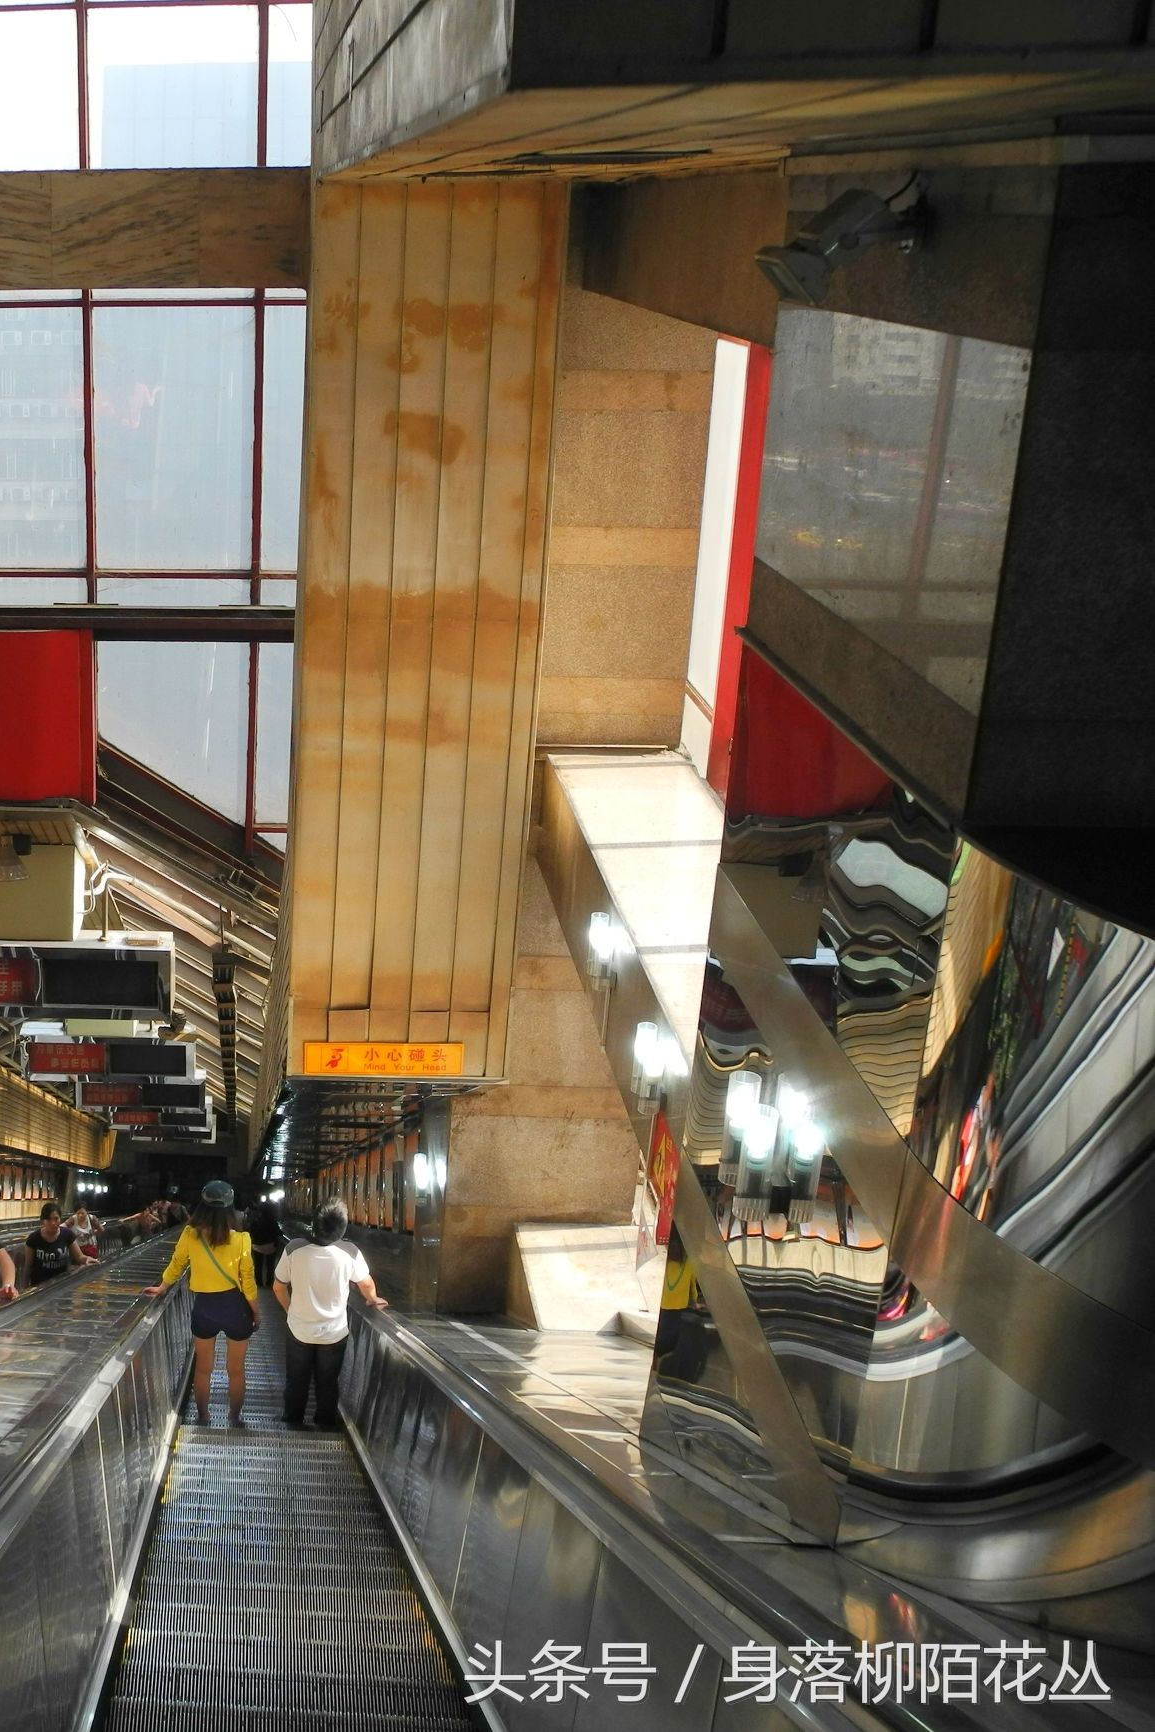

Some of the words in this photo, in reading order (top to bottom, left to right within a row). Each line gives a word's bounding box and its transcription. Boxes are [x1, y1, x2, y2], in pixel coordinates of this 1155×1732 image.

[365, 1048, 447, 1062] 小心碰头
[364, 1063, 385, 1071] Mind
[394, 1063, 414, 1071] Your
[423, 1063, 446, 1071] Head
